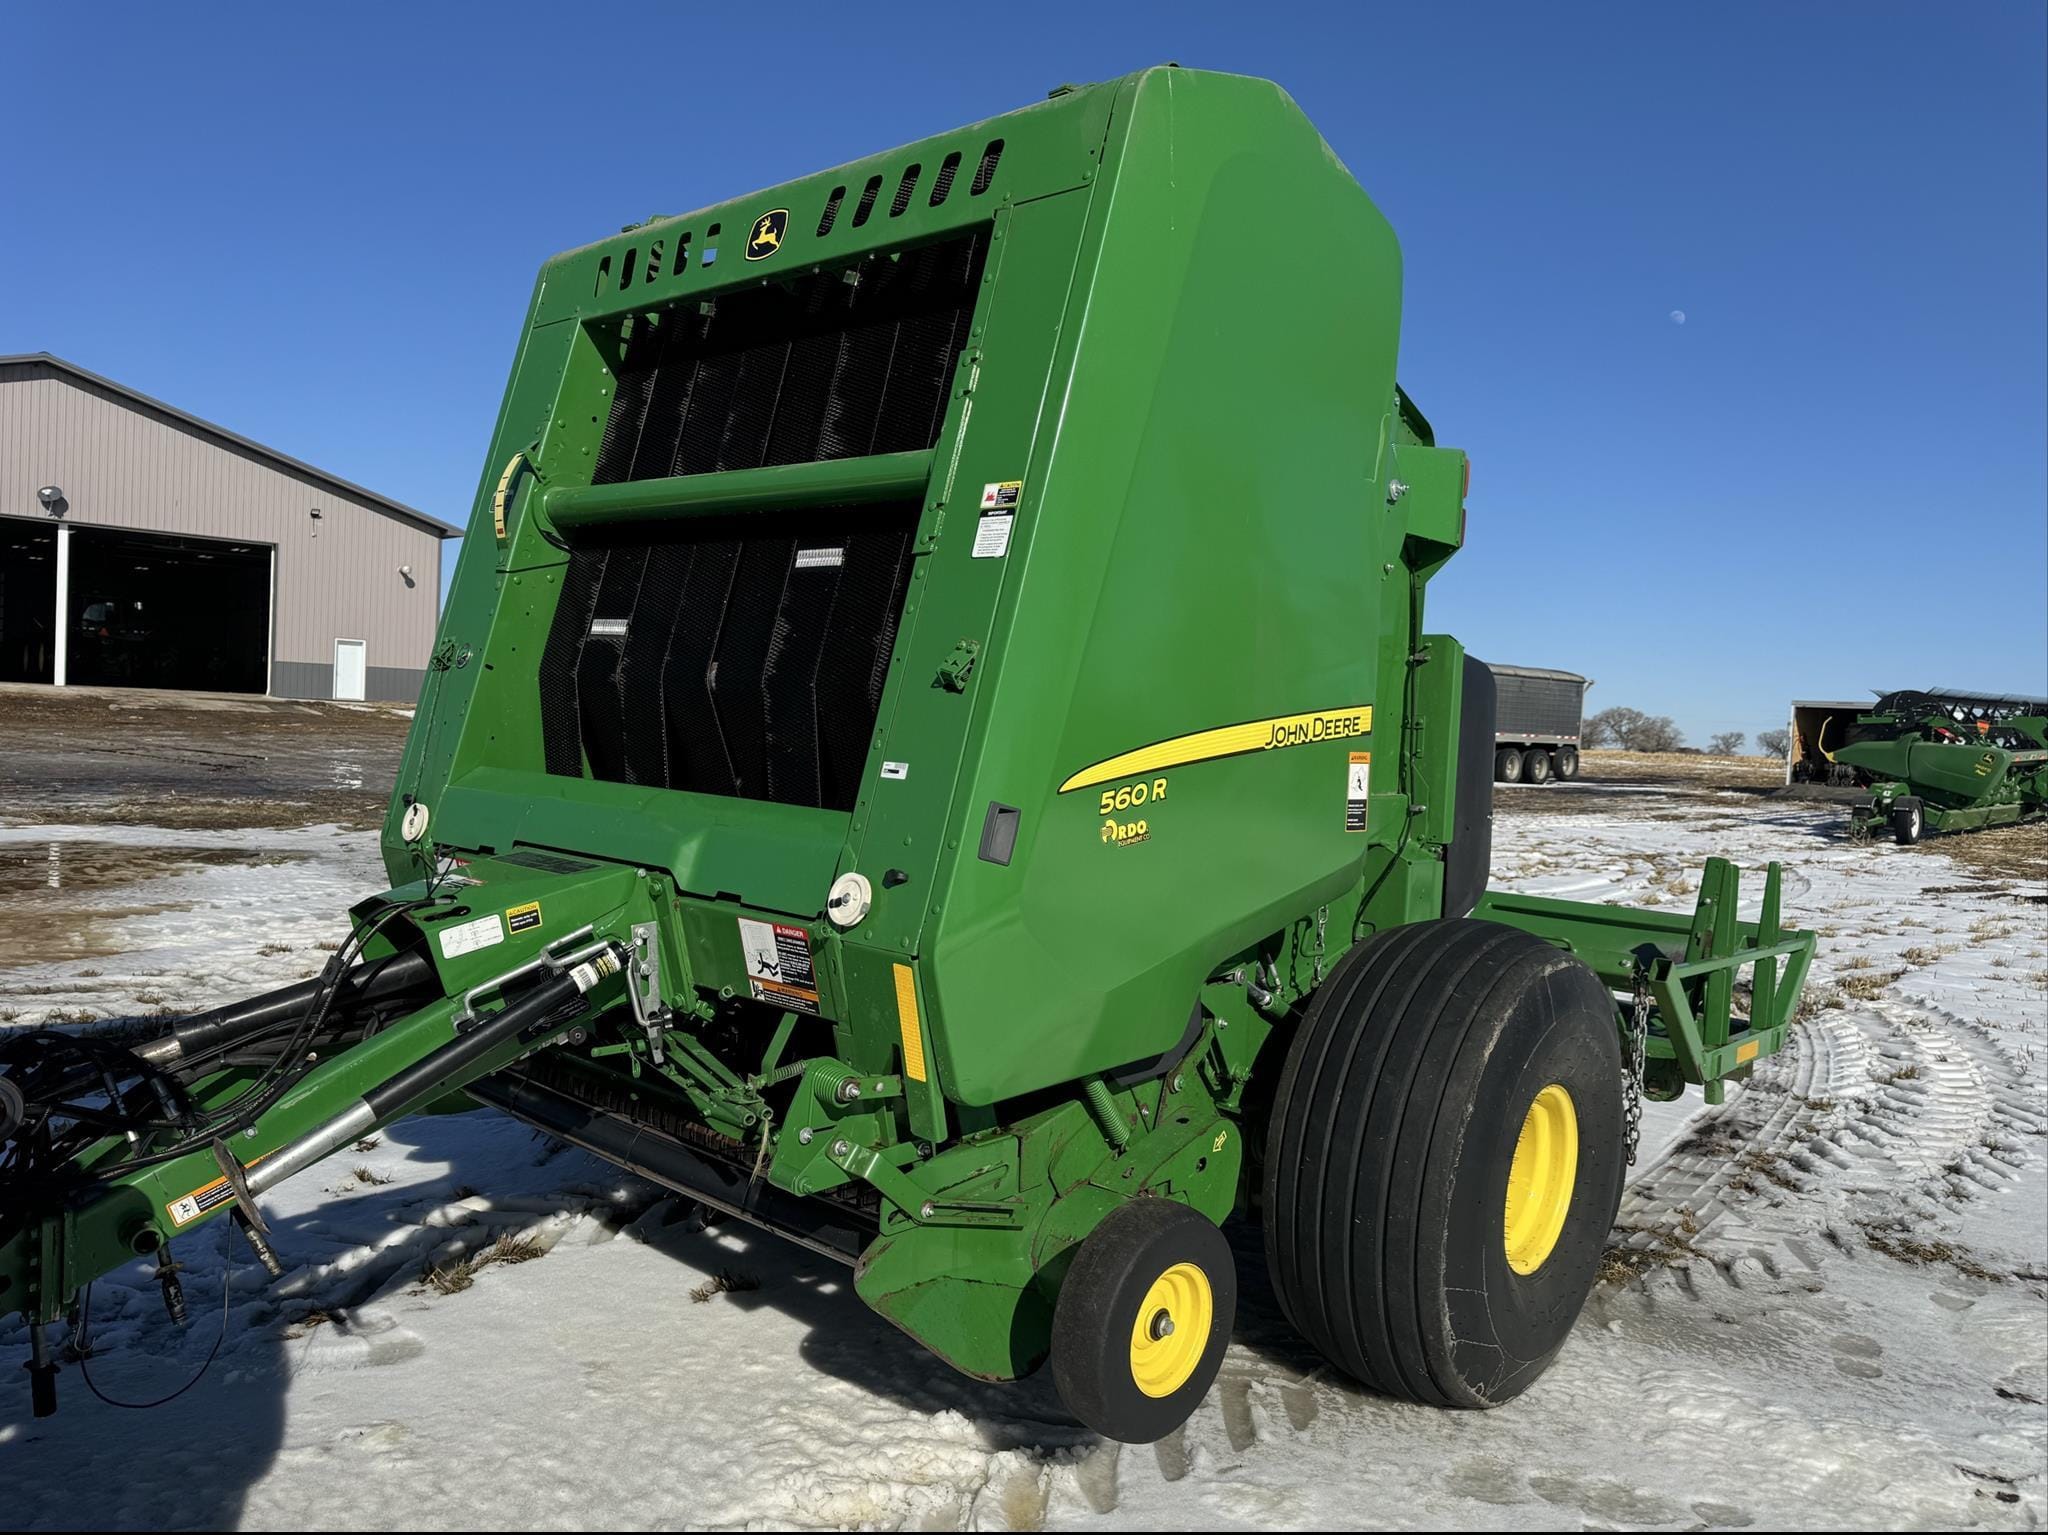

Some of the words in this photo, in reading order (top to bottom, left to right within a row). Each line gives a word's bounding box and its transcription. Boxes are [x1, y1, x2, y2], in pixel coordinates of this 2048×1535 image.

[1265, 723, 1309, 746] JOHN
[1312, 716, 1361, 738] DEERE
[1099, 783, 1148, 814] 560
[1151, 778, 1168, 802] R
[781, 927, 804, 938] DANGER
